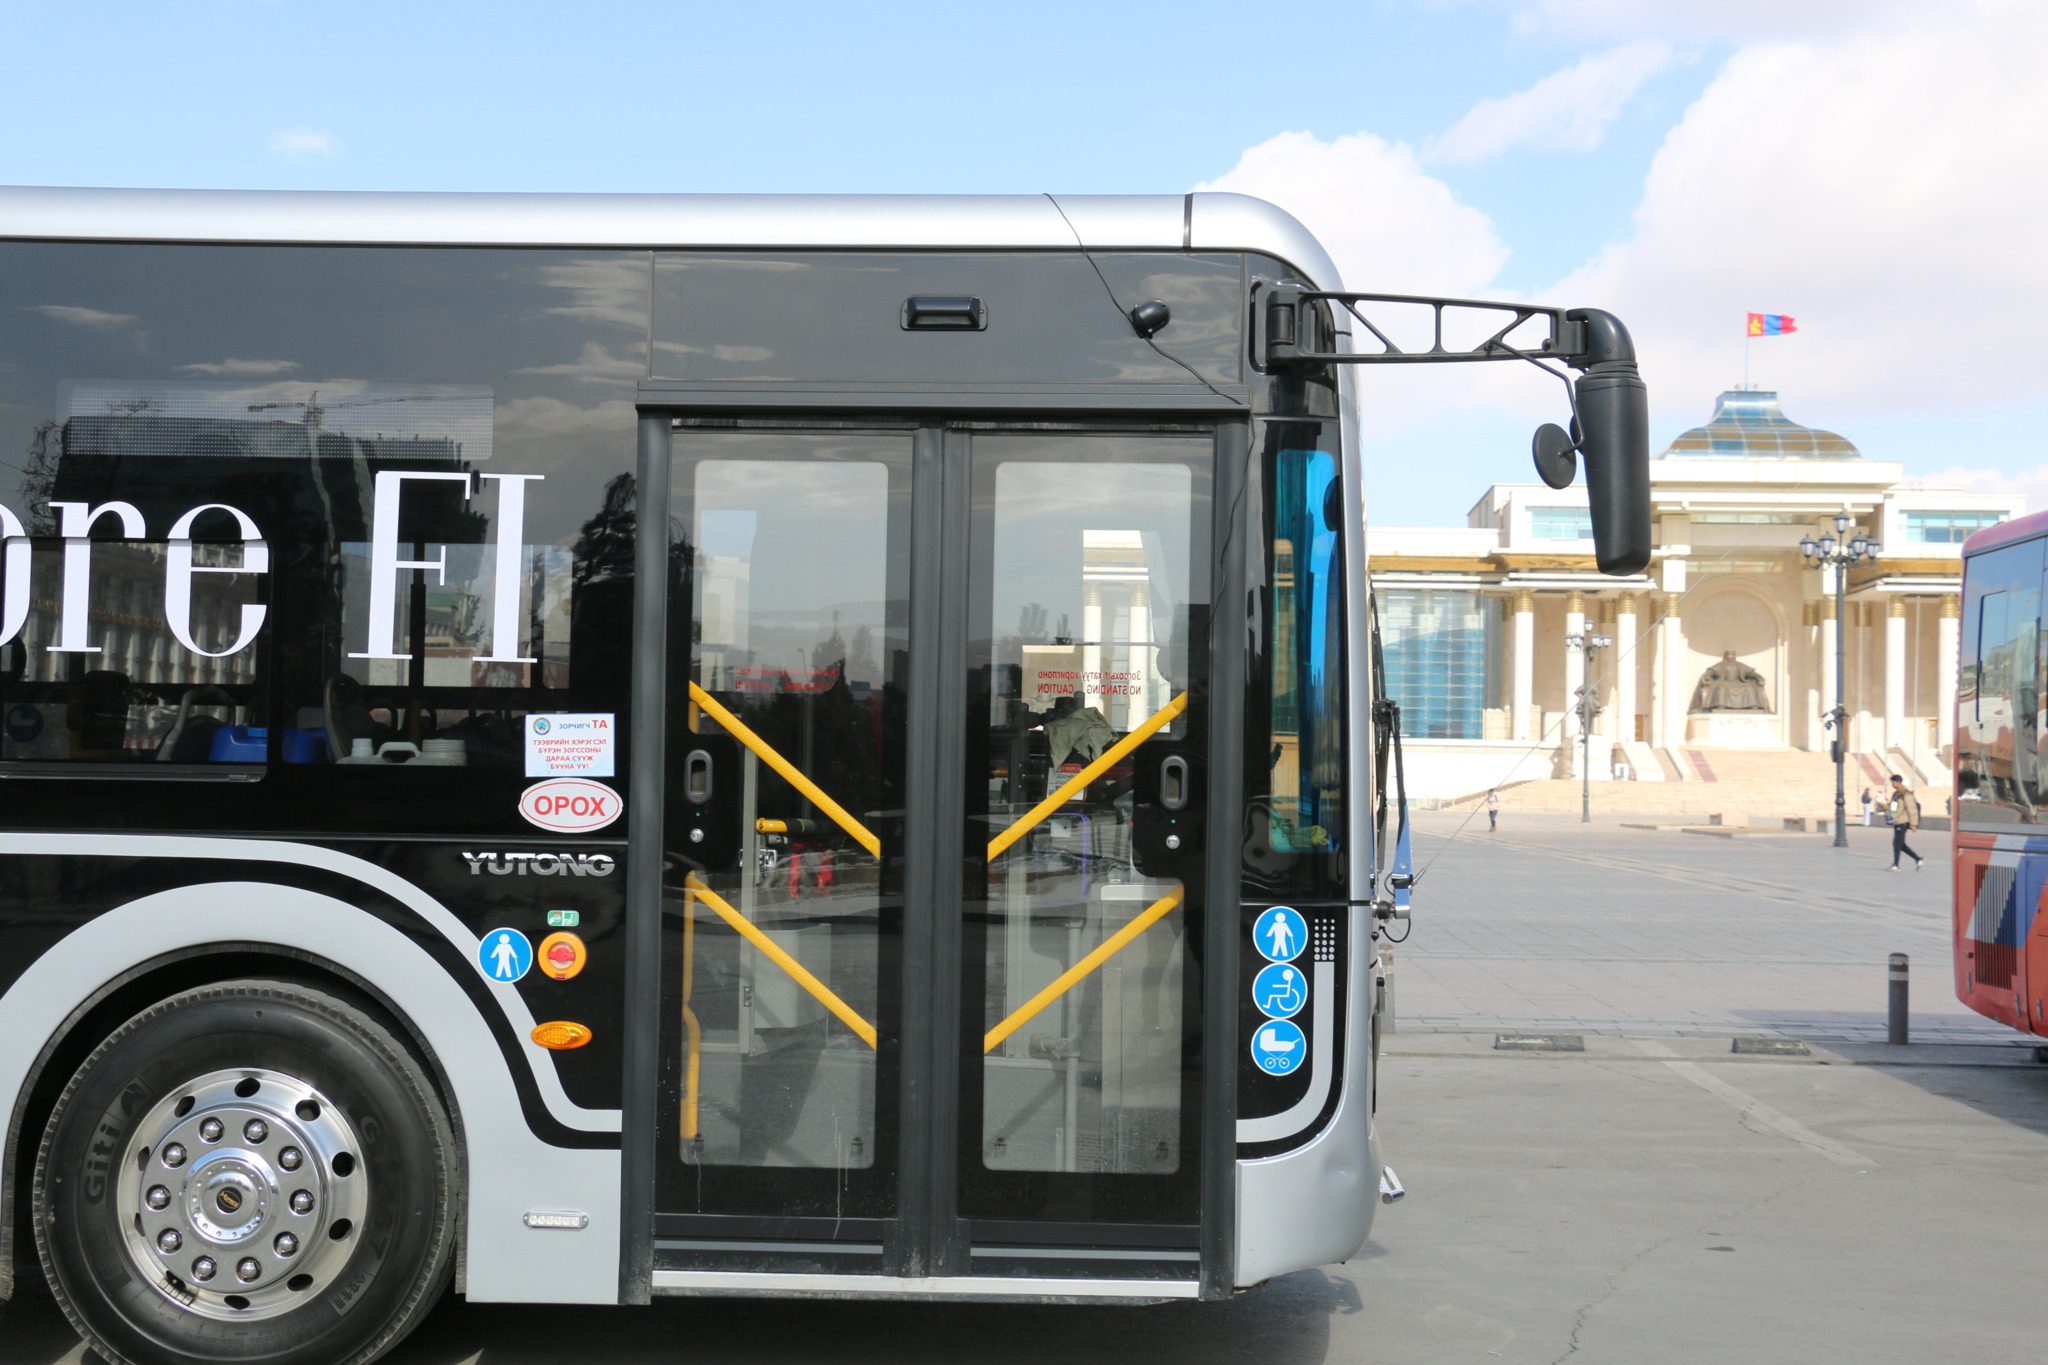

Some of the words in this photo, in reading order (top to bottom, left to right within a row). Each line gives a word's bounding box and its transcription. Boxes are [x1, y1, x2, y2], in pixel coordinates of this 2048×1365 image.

[0, 500, 270, 658] re
[592, 719, 608, 729] ТА
[534, 796, 606, 817] ОРОХ
[462, 852, 615, 877] YUTONG
[84, 1124, 122, 1206] Giti
[333, 1270, 367, 1310] 公交专用
